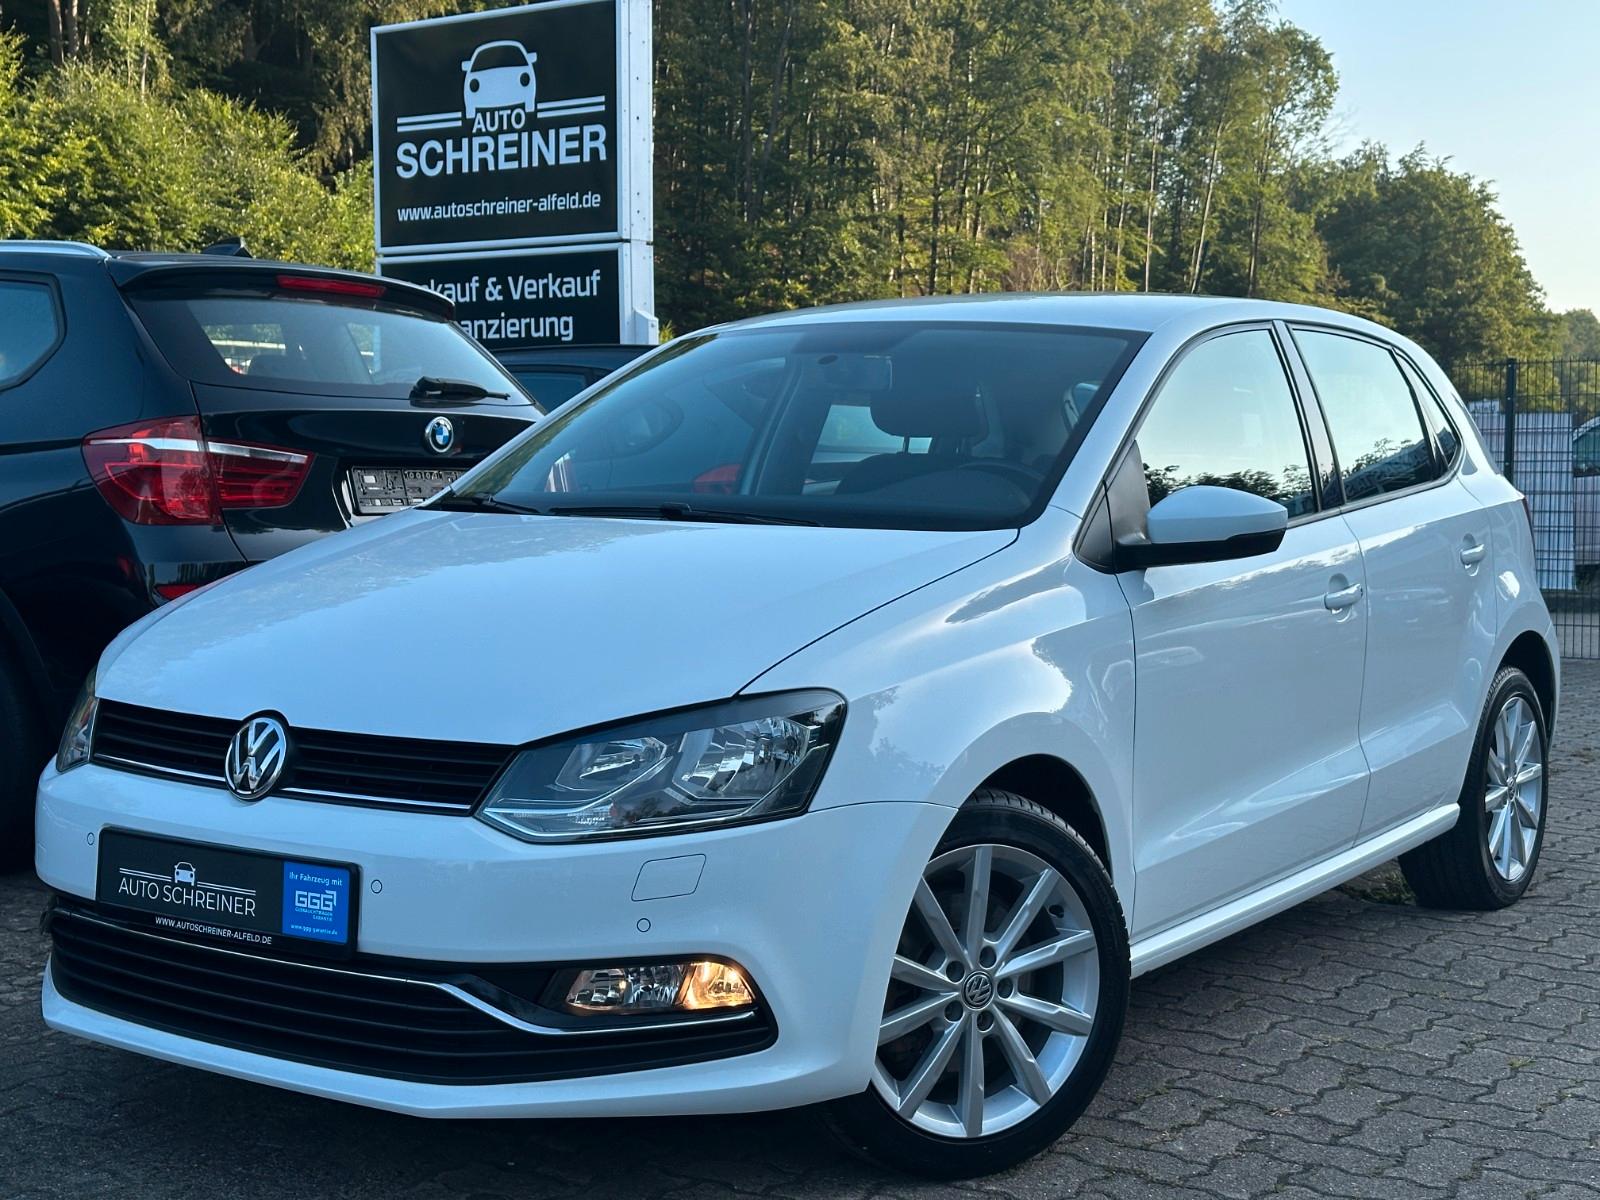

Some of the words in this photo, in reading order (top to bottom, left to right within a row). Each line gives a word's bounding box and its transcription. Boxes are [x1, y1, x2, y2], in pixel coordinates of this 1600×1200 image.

[472, 108, 526, 133] AUTO
[396, 124, 607, 178] SCHREINER
[397, 191, 601, 221] www.autoschreiner-alfeld.de
[485, 277, 504, 302] &
[508, 269, 601, 299] Verkauf
[461, 312, 574, 342] anzierung
[300, 873, 330, 886] Fahrzeug
[331, 877, 343, 886] mit
[118, 877, 160, 900] AUTO
[162, 891, 257, 917] SCHREINER
[295, 890, 336, 911] GGG
[155, 916, 272, 945] WWW.AUTOSCHREINER-ALFELD.DE
